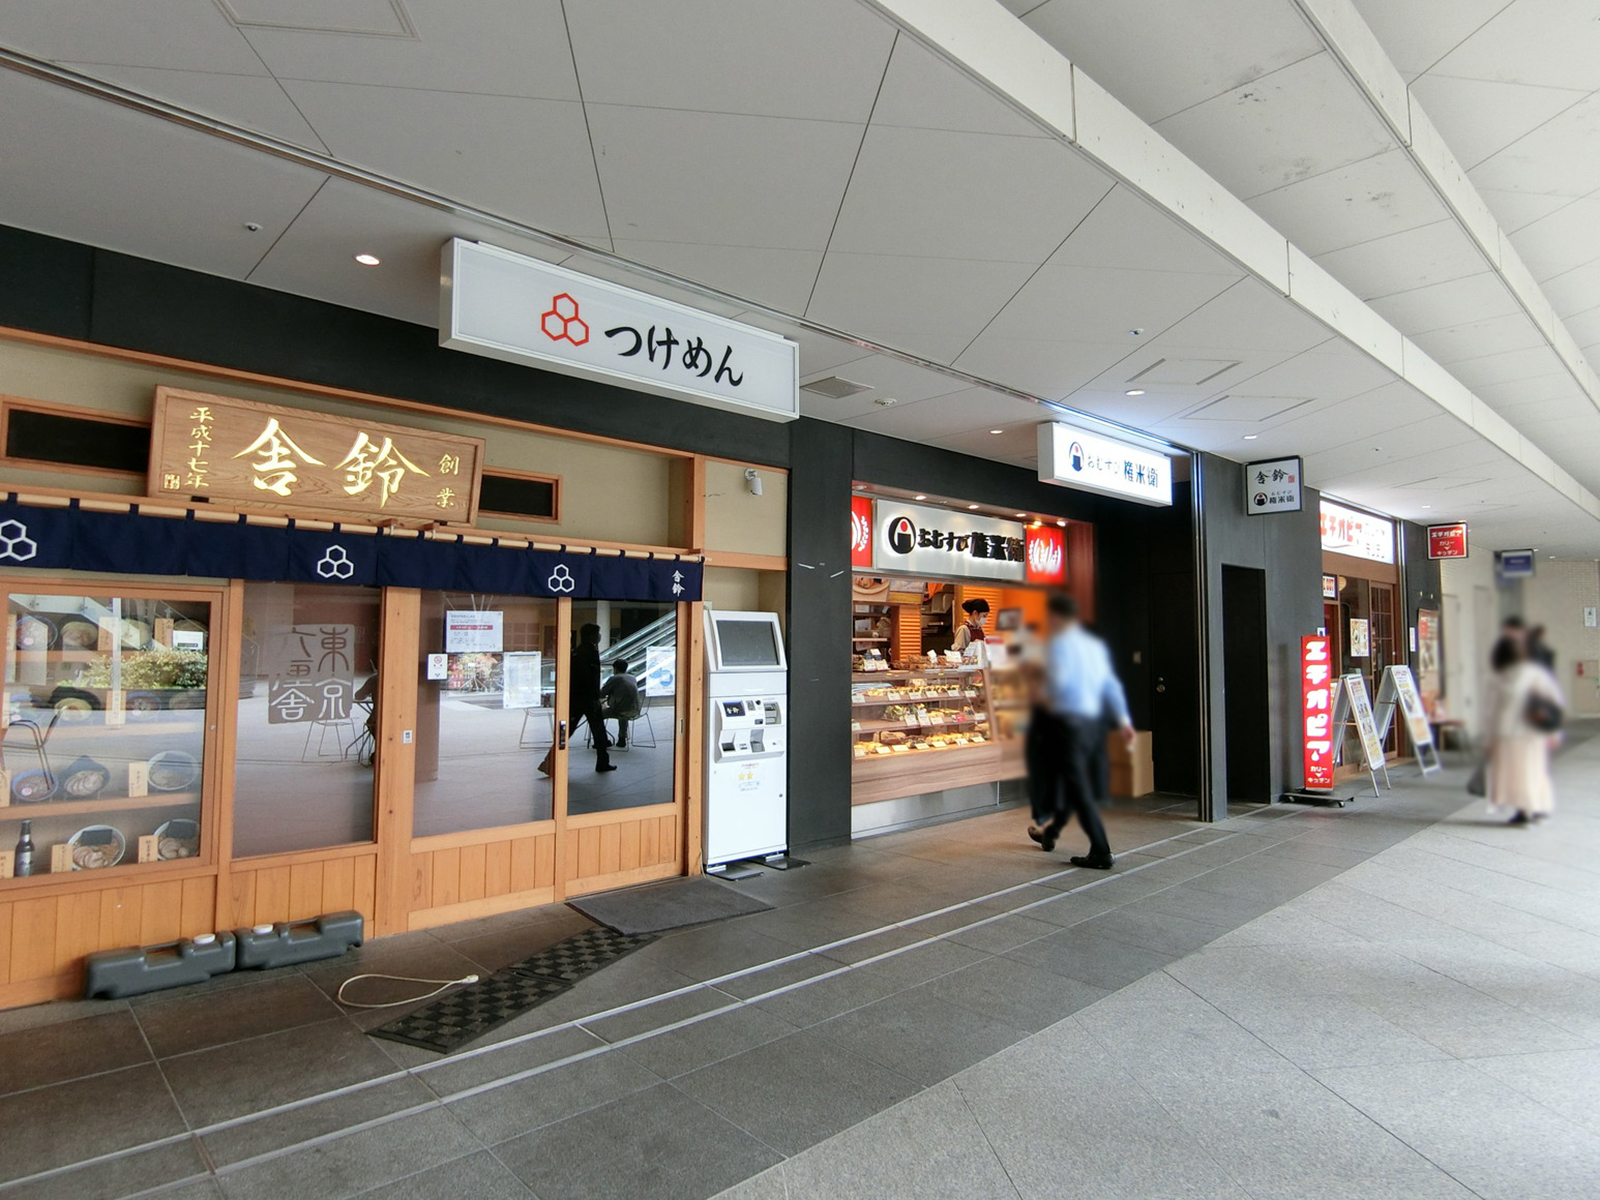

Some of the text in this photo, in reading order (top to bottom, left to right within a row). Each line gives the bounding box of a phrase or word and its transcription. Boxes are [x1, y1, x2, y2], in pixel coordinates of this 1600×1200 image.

[604, 325, 743, 386] つけめん
[184, 406, 214, 488] 平成十七年
[231, 416, 431, 510] 舎鈴
[436, 453, 460, 508] 創業
[672, 570, 685, 597] 舎鈴
[1305, 641, 1331, 755] エチオピア
[1307, 777, 1331, 785] キッチン
